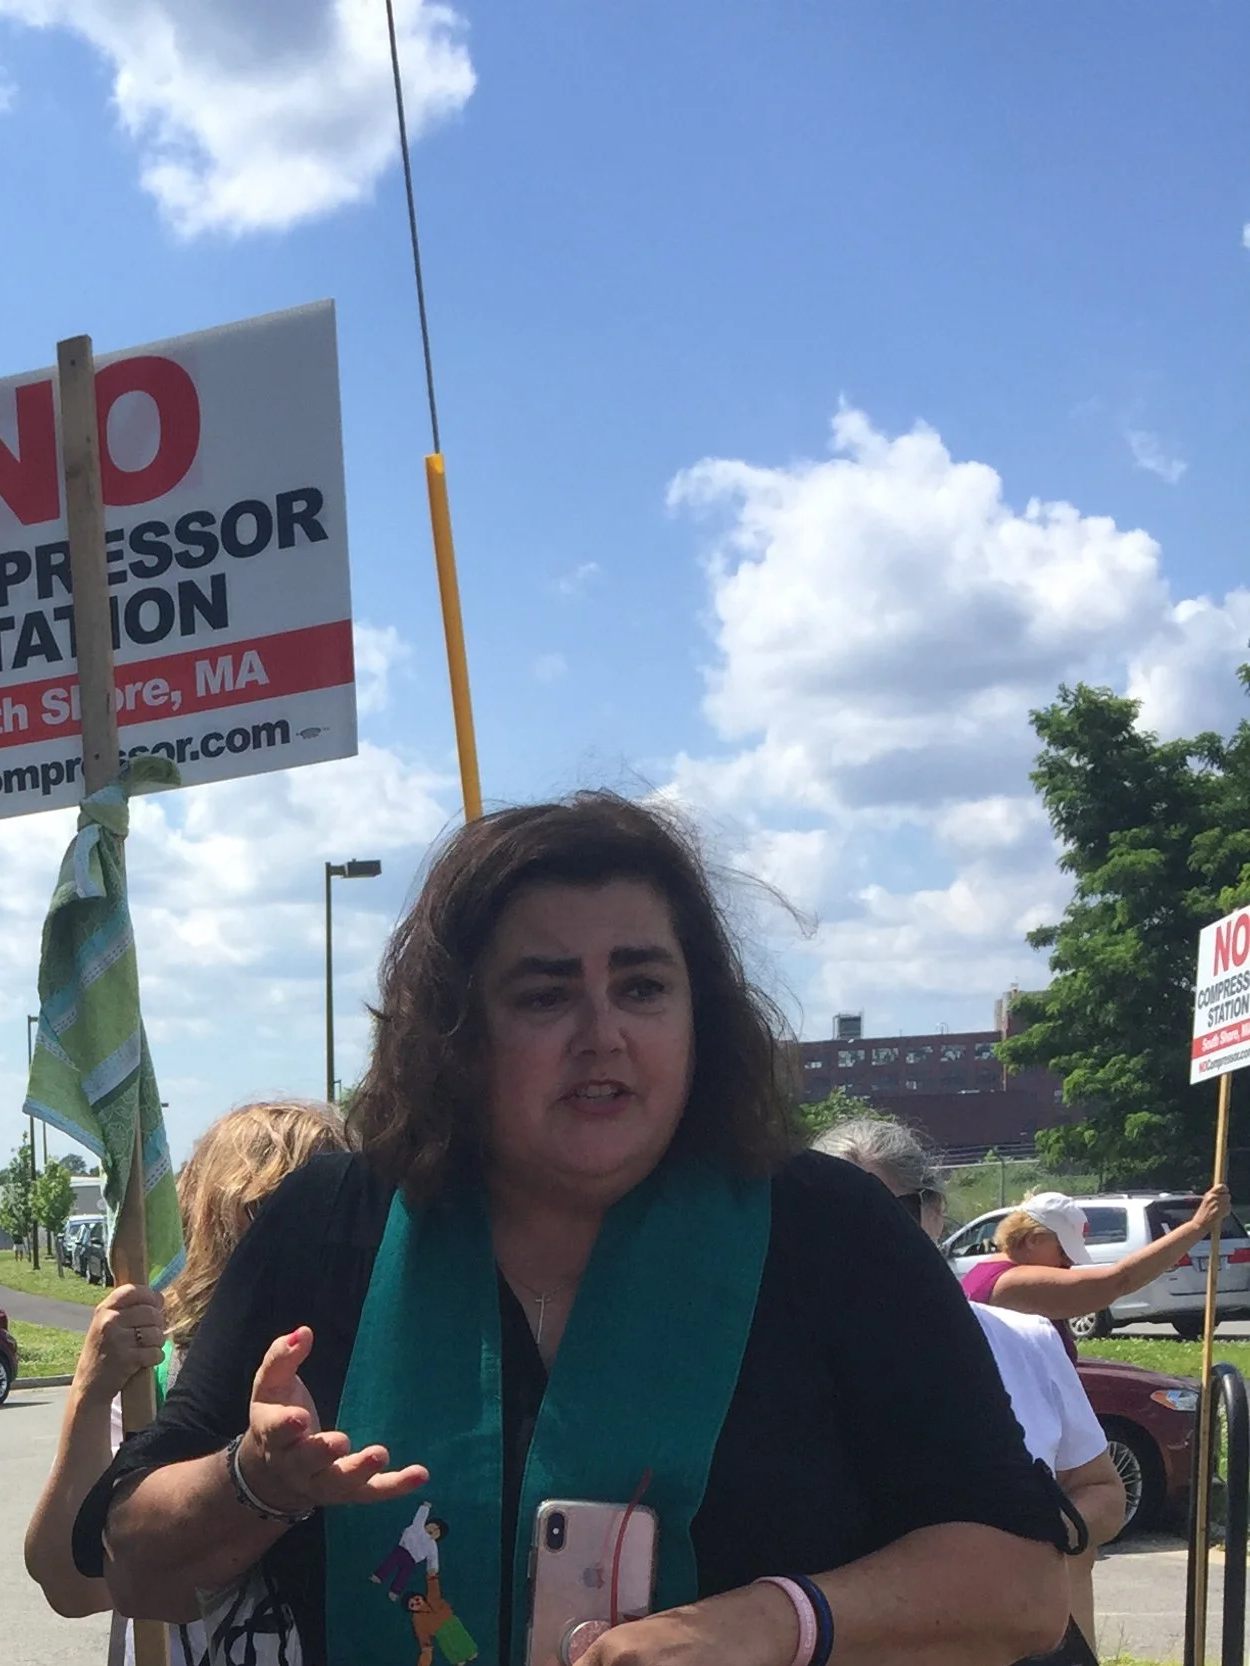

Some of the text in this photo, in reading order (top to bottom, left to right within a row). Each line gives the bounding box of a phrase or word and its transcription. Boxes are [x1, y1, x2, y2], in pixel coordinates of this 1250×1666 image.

[194, 650, 270, 698] MA
[1213, 912, 1250, 977] NO
[1197, 970, 1250, 1010] COMPRESS
[1207, 992, 1250, 1028] STATION
[1199, 1047, 1250, 1074] NOCompressor.co
